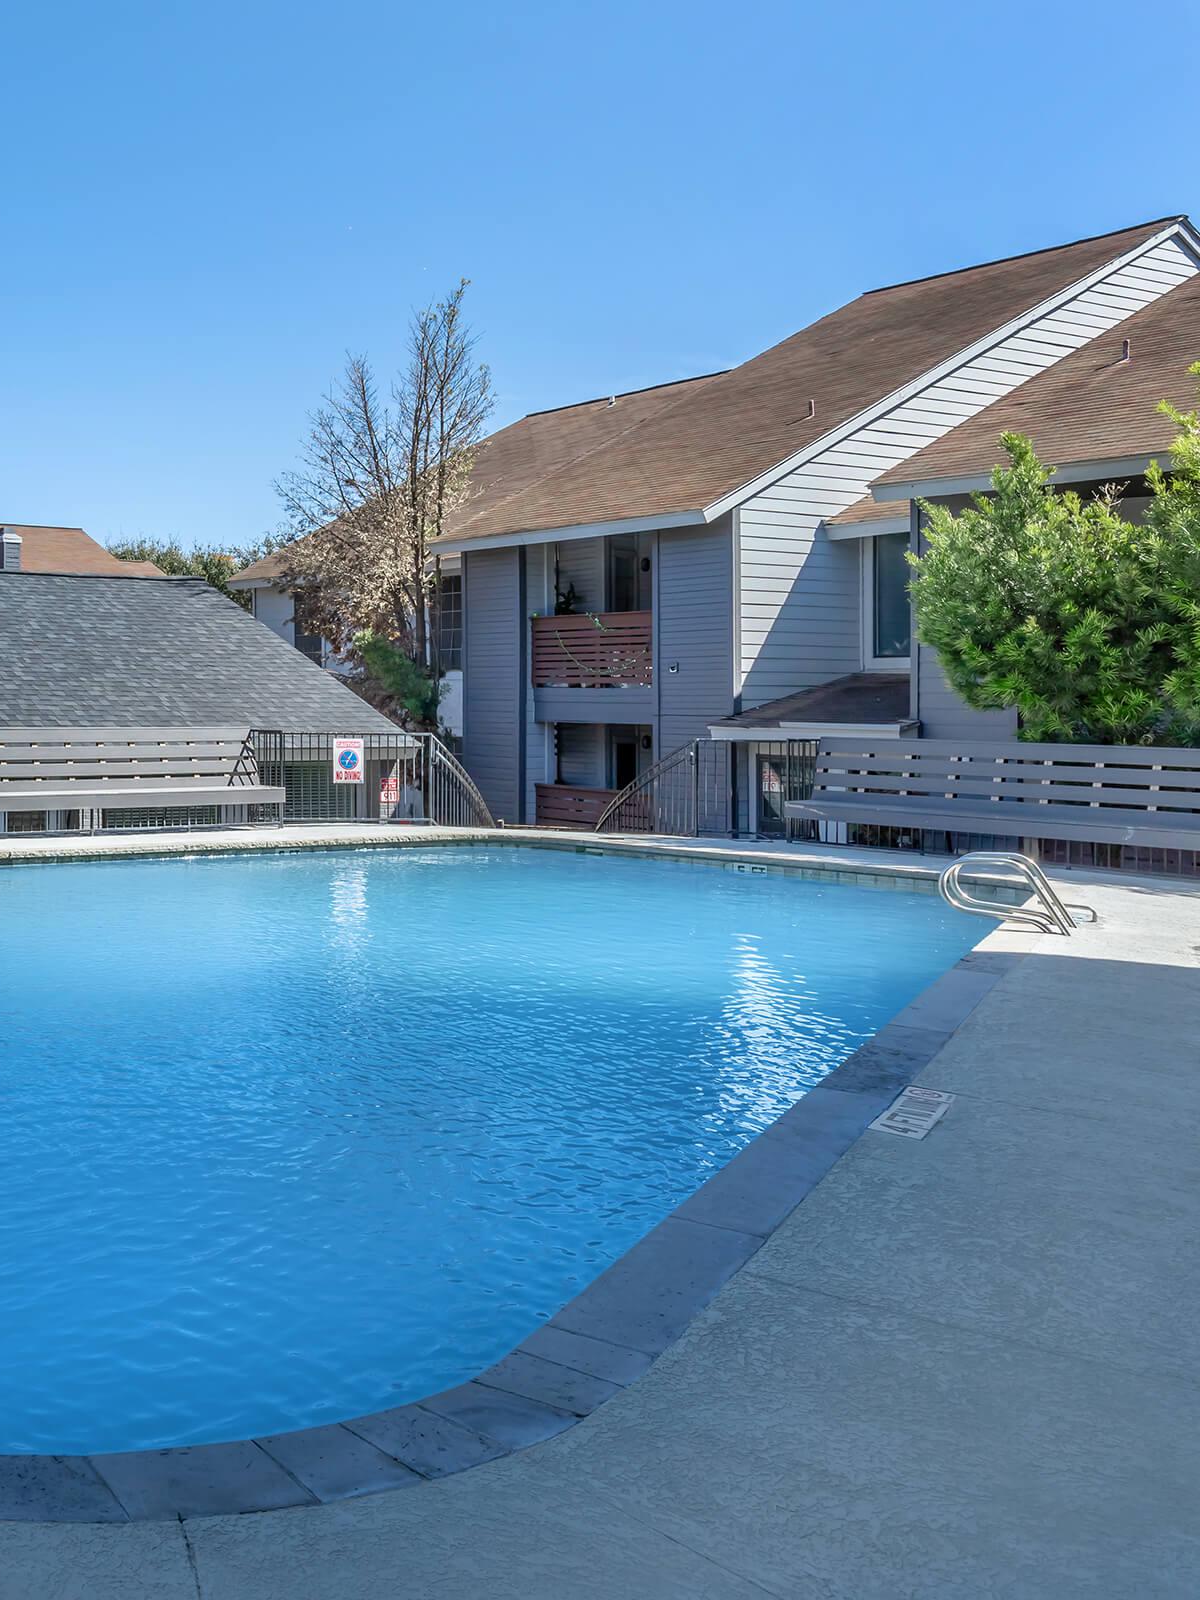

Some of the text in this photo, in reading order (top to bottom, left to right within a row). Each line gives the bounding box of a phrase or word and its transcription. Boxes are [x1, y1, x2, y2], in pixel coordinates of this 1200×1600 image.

[336, 771, 361, 780] NO DIVING
[384, 792, 396, 800] 911
[880, 1122, 919, 1134] 4
